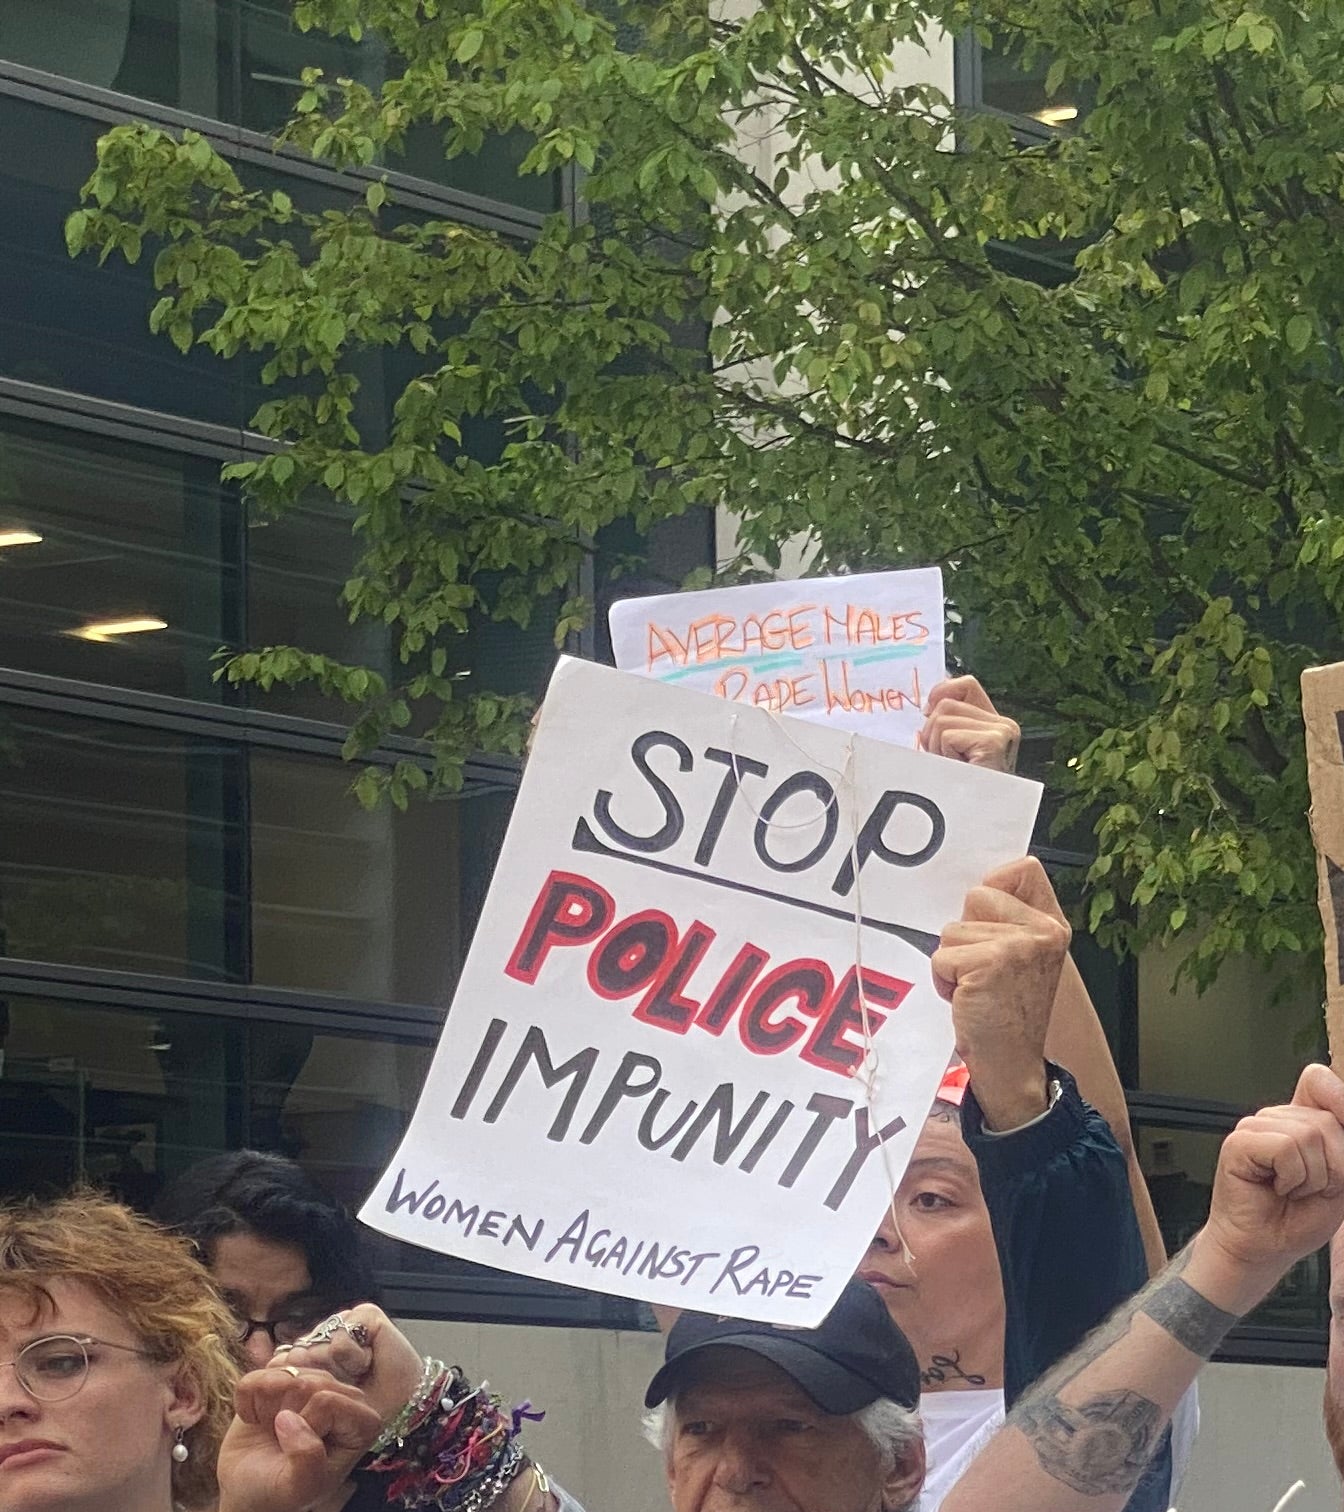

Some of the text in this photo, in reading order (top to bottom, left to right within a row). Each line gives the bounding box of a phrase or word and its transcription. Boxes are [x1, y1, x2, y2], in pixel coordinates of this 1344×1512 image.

[647, 604, 930, 671] AVERAGE MALES
[820, 660, 921, 715] WOMEN
[593, 731, 946, 897] STOP
[504, 870, 915, 1079] POLICE
[449, 1018, 907, 1212] IMPUNITY
[385, 1168, 824, 1299] WOMEN AGAINST RAPE
